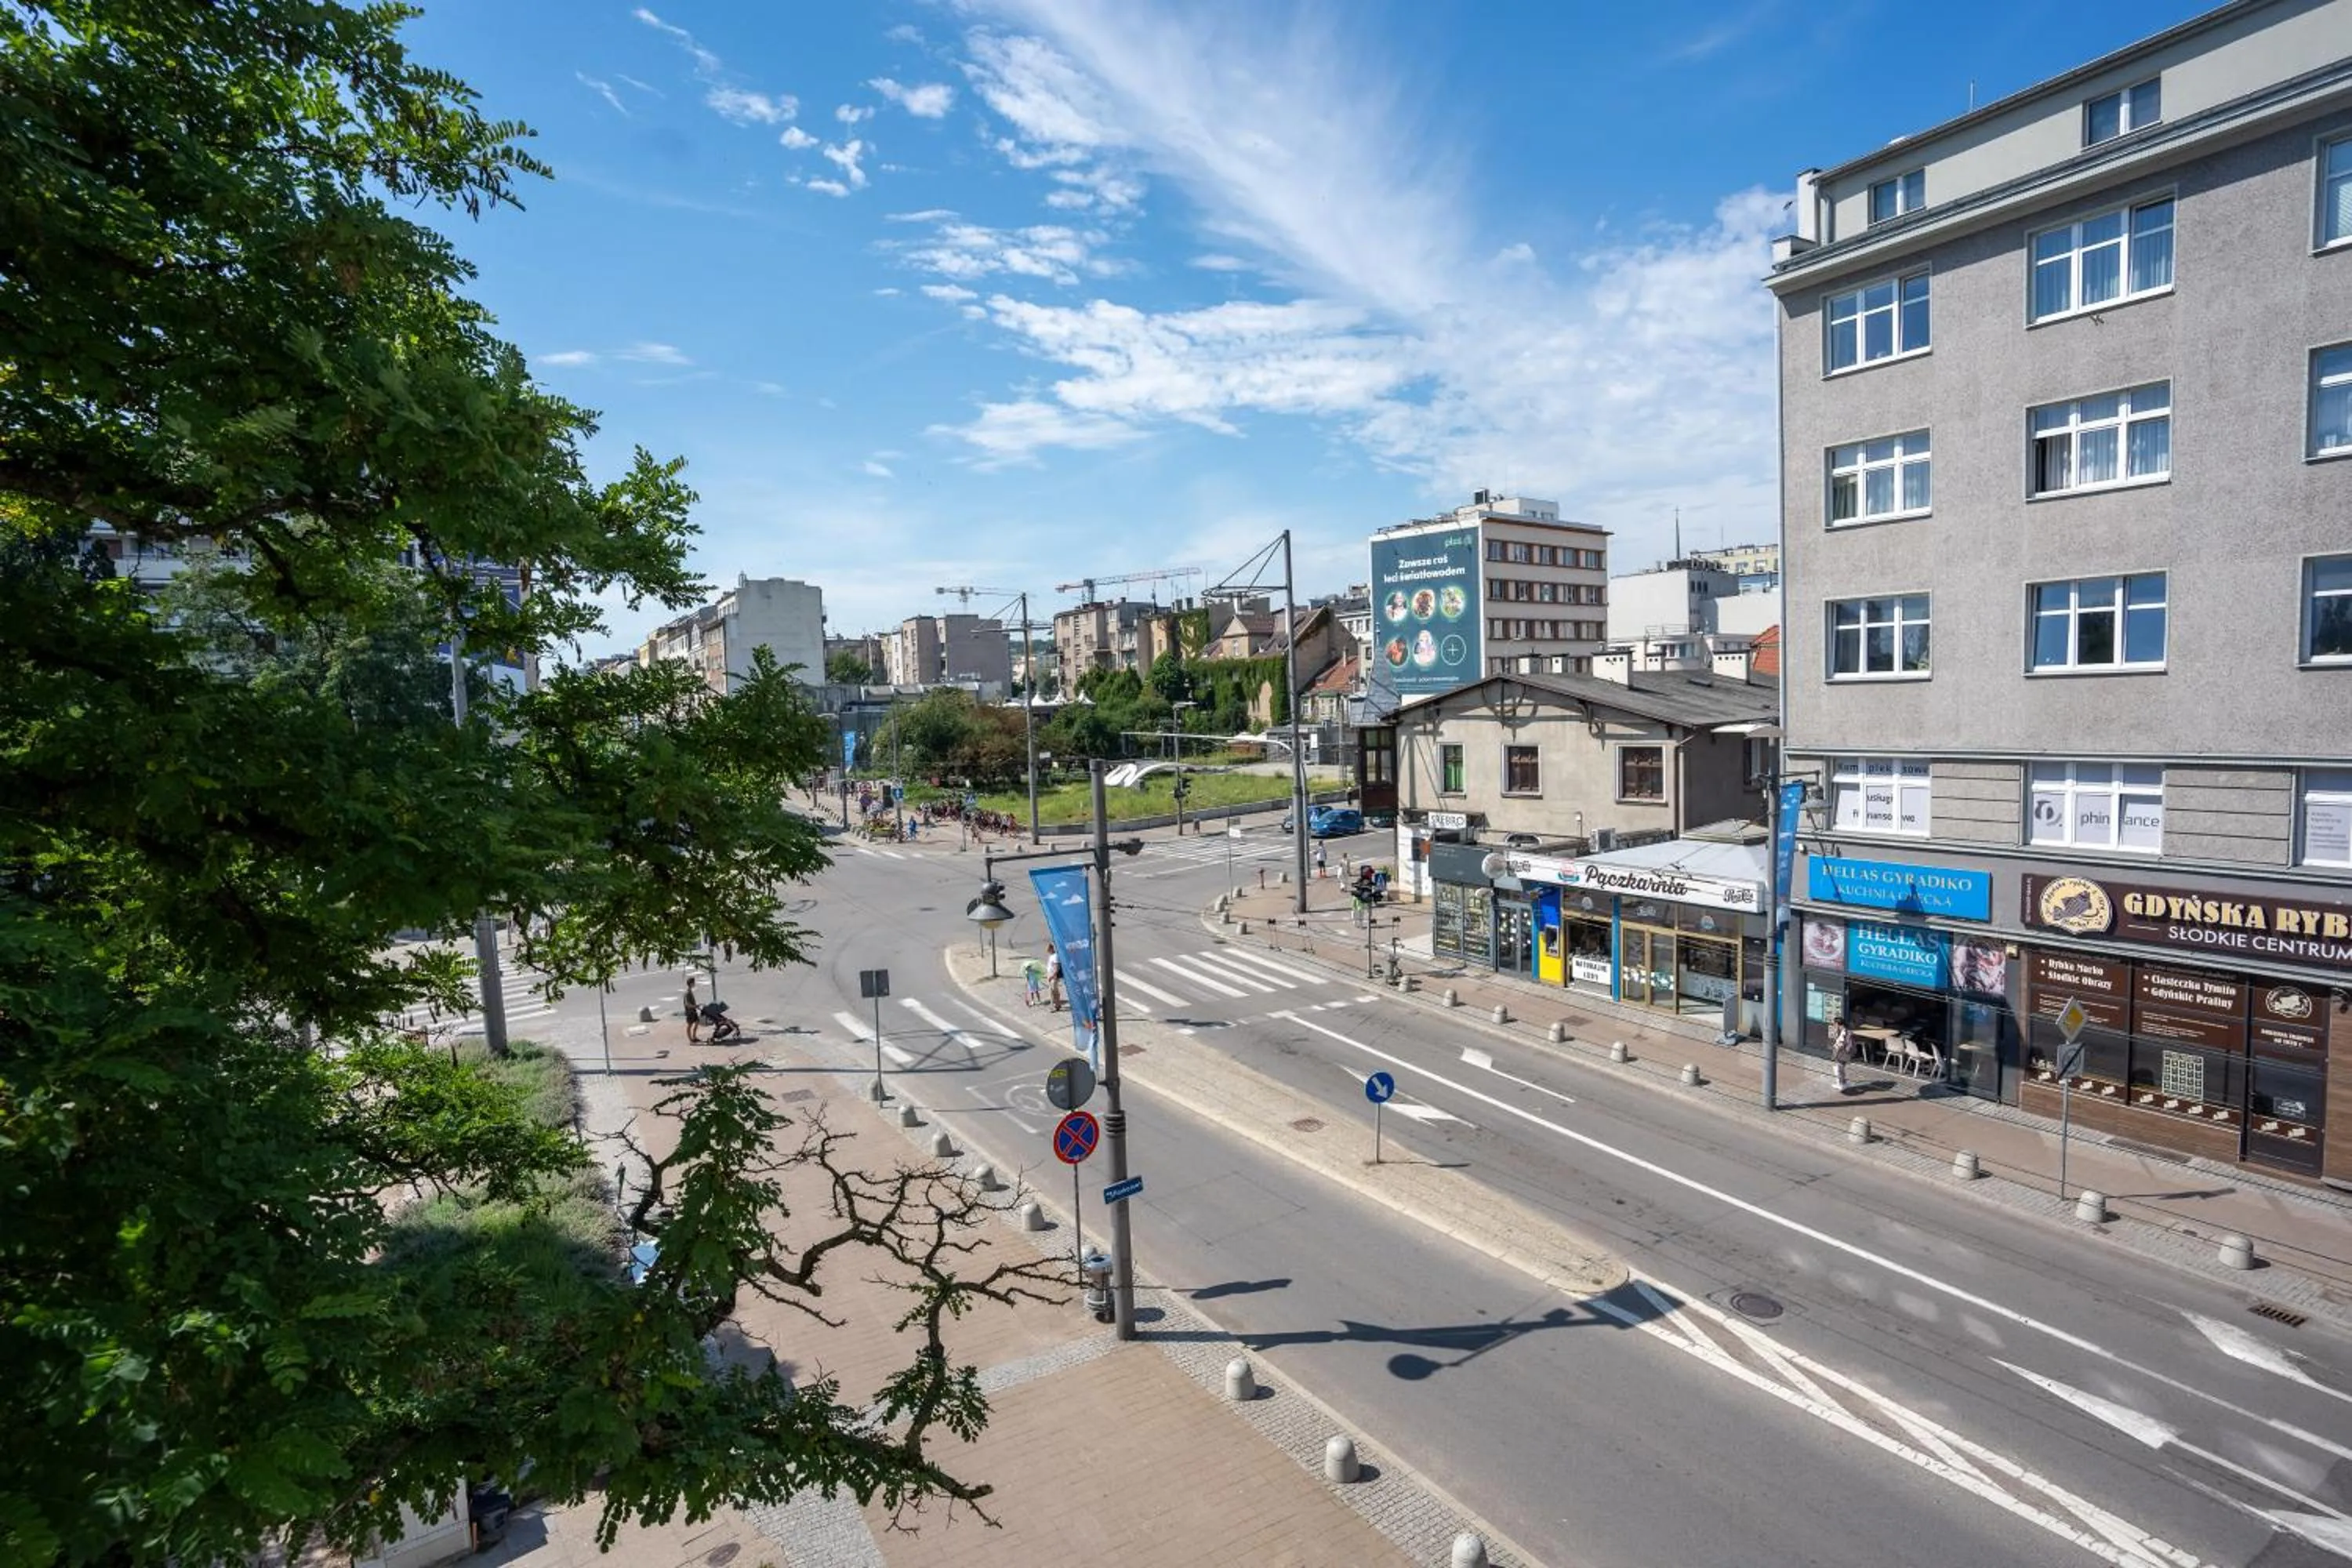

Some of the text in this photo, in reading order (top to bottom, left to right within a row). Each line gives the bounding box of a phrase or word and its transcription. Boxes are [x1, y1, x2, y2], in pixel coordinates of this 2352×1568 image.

[1584, 865, 1688, 896] Pączkarnia
[1822, 865, 1973, 891] HELLAS GYRADIKO
[1838, 884, 1896, 901] KUCHNIA
[2124, 892, 2267, 929] GDYŃSKA
[2275, 907, 2352, 938] RYB
[1857, 924, 1940, 949] HELLAS
[2168, 926, 2352, 960] SŁODKIE CENTRUM
[1858, 943, 1938, 965] GYRADIKO
